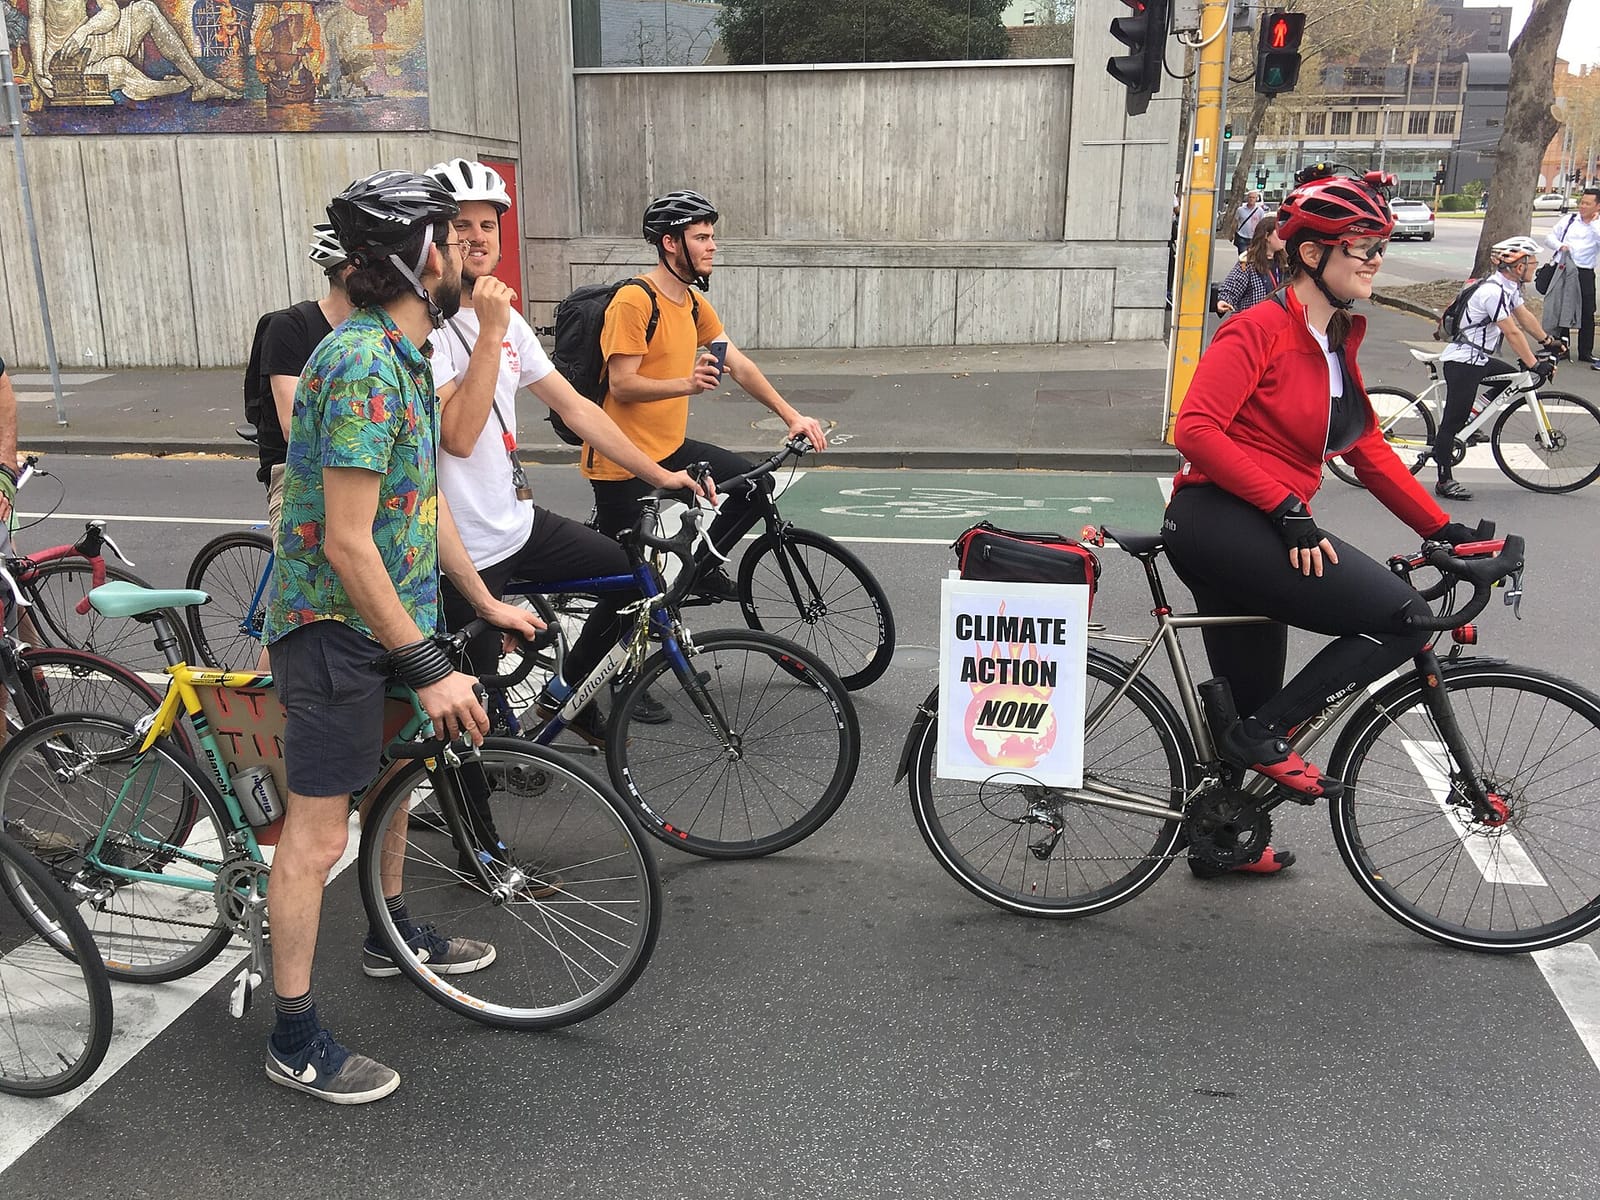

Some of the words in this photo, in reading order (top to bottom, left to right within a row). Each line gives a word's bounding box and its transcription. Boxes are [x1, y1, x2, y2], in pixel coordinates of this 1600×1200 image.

[955, 613, 1067, 646] CLIMATE
[571, 654, 618, 711] LeMond
[960, 656, 1057, 688] ACTION
[977, 699, 1049, 730] NOW
[205, 749, 229, 796] Bianchi
[252, 774, 273, 814] Bianchi
